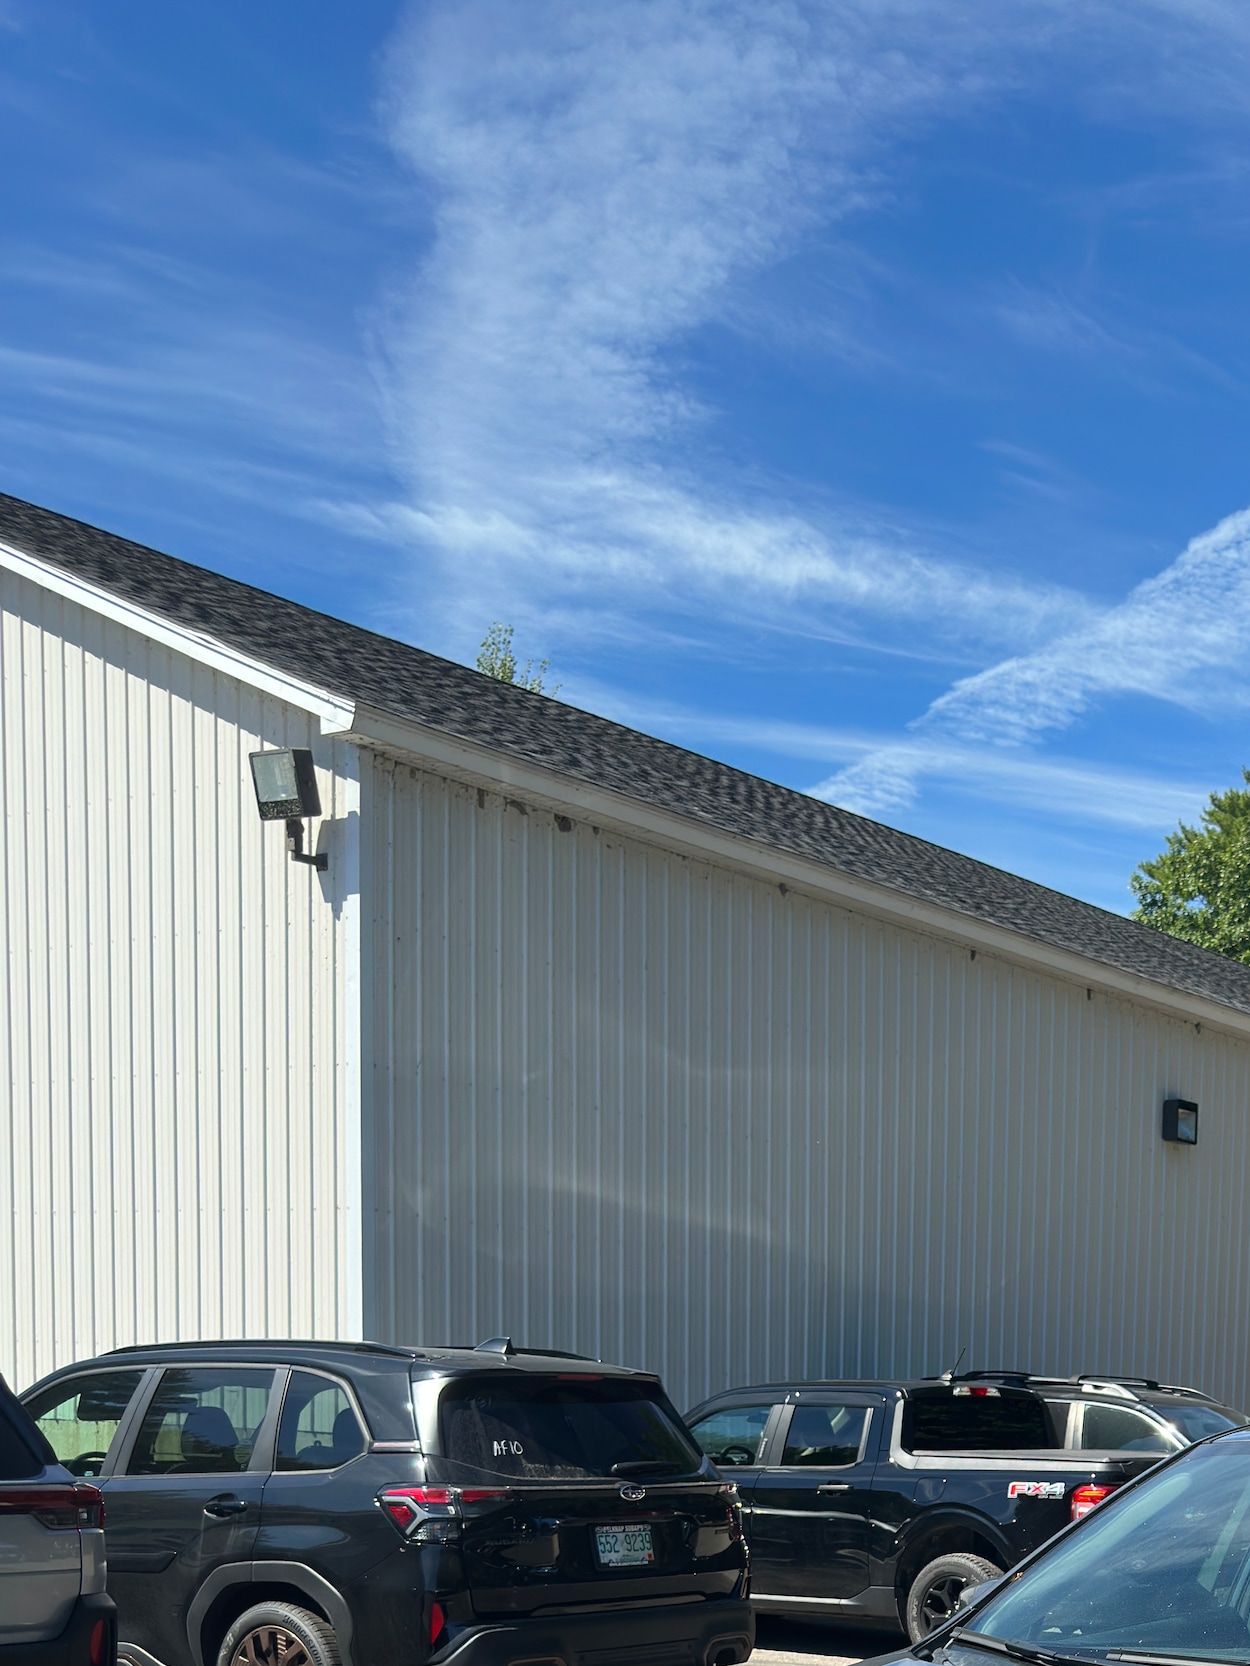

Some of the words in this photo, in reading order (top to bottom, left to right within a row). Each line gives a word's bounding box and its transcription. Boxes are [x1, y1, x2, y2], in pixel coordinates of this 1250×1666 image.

[1007, 1481, 1066, 1499] FX4
[598, 1534, 620, 1554] 552
[624, 1532, 652, 1552] 9239
[282, 1614, 324, 1666] BRIDGESTONE
